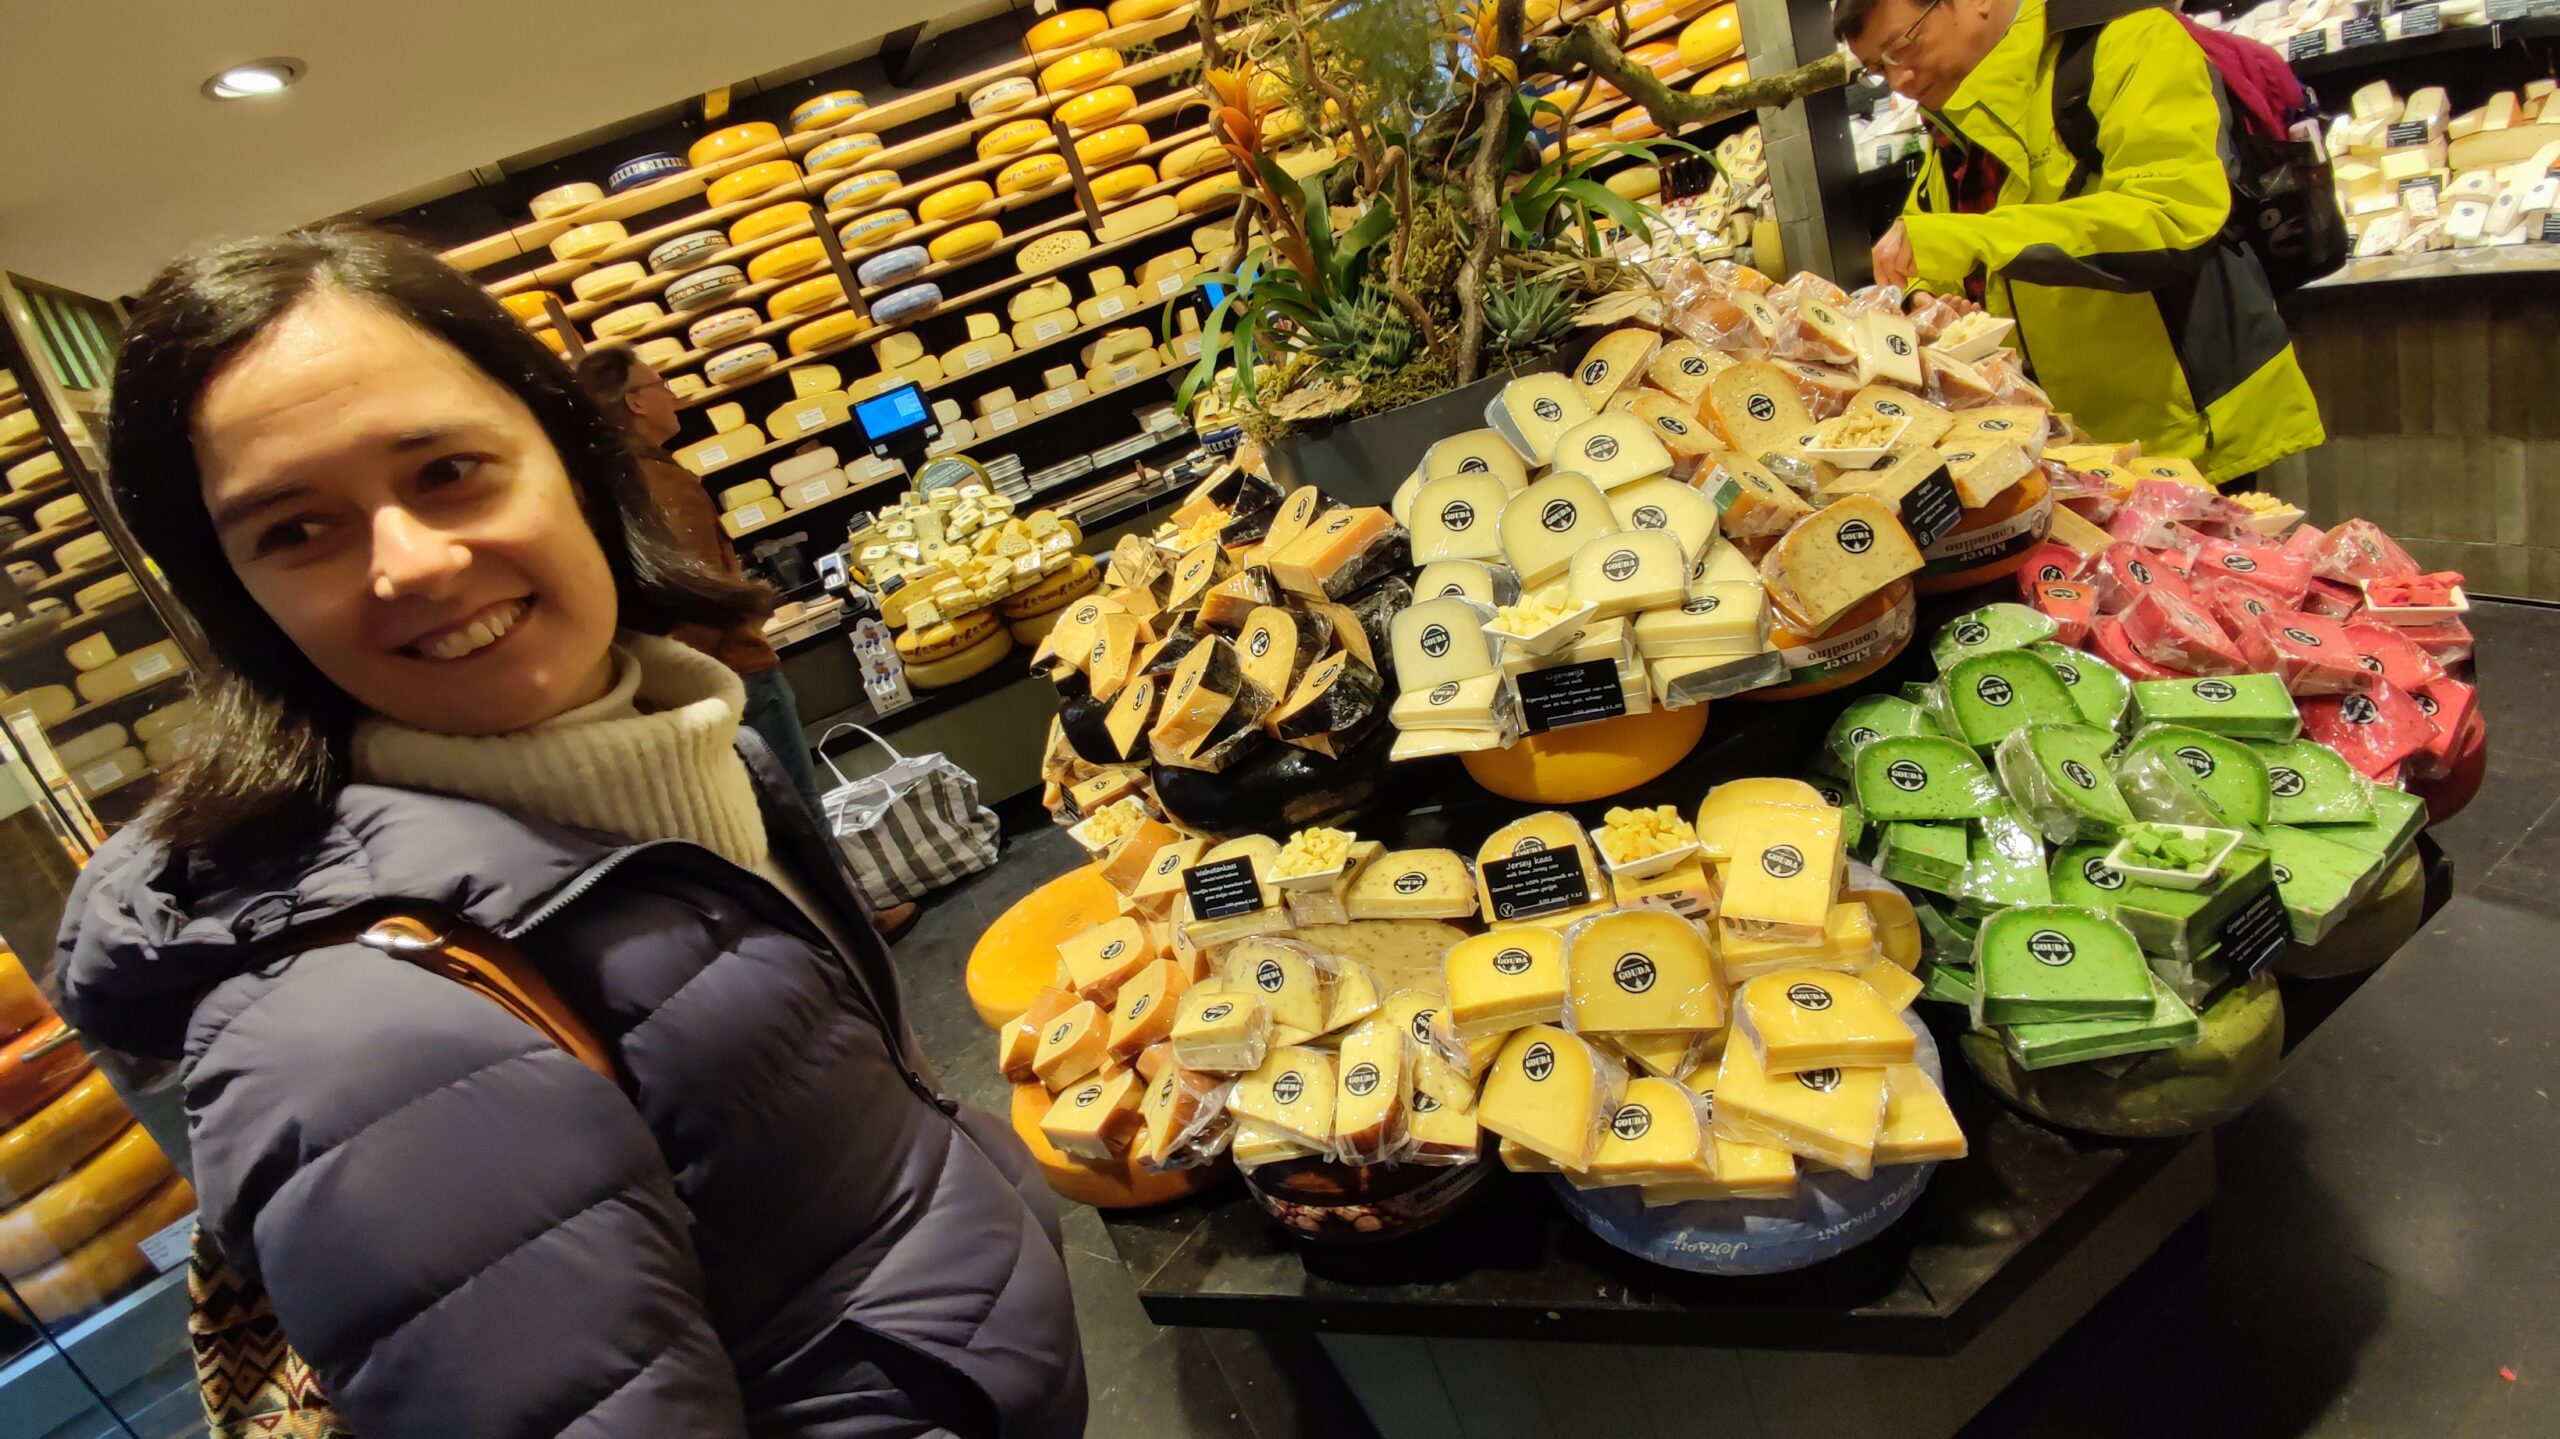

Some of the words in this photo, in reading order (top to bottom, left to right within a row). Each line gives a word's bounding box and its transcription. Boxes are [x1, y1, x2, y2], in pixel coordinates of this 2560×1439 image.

[1444, 509, 1470, 521] GOUDA
[1546, 505, 1572, 524] GOUDA
[1841, 533, 1870, 541] GOUDA
[1606, 559, 1635, 571] GOUDA
[1424, 634, 1448, 647] GOUDA
[1808, 629, 1879, 660] Contadino
[1823, 647, 1871, 671] Klaver
[1981, 684, 2008, 697] GOUDA
[1892, 770, 1921, 781] GOUDA
[1505, 859, 1532, 871] Jersey
[1534, 855, 1553, 865] kaas
[1765, 852, 1799, 869] GOUDA
[2033, 944, 2070, 953] GOUDA
[1497, 956, 1529, 966] GOUDA
[1618, 965, 1651, 981] GOUDA
[1792, 991, 1827, 1001] GOUDA
[1525, 1056, 1552, 1069] GOUDA
[1348, 1074, 1376, 1085] GOUDA
[1615, 1117, 1648, 1129] GOUDA
[1672, 1231, 1749, 1261] Jersey
